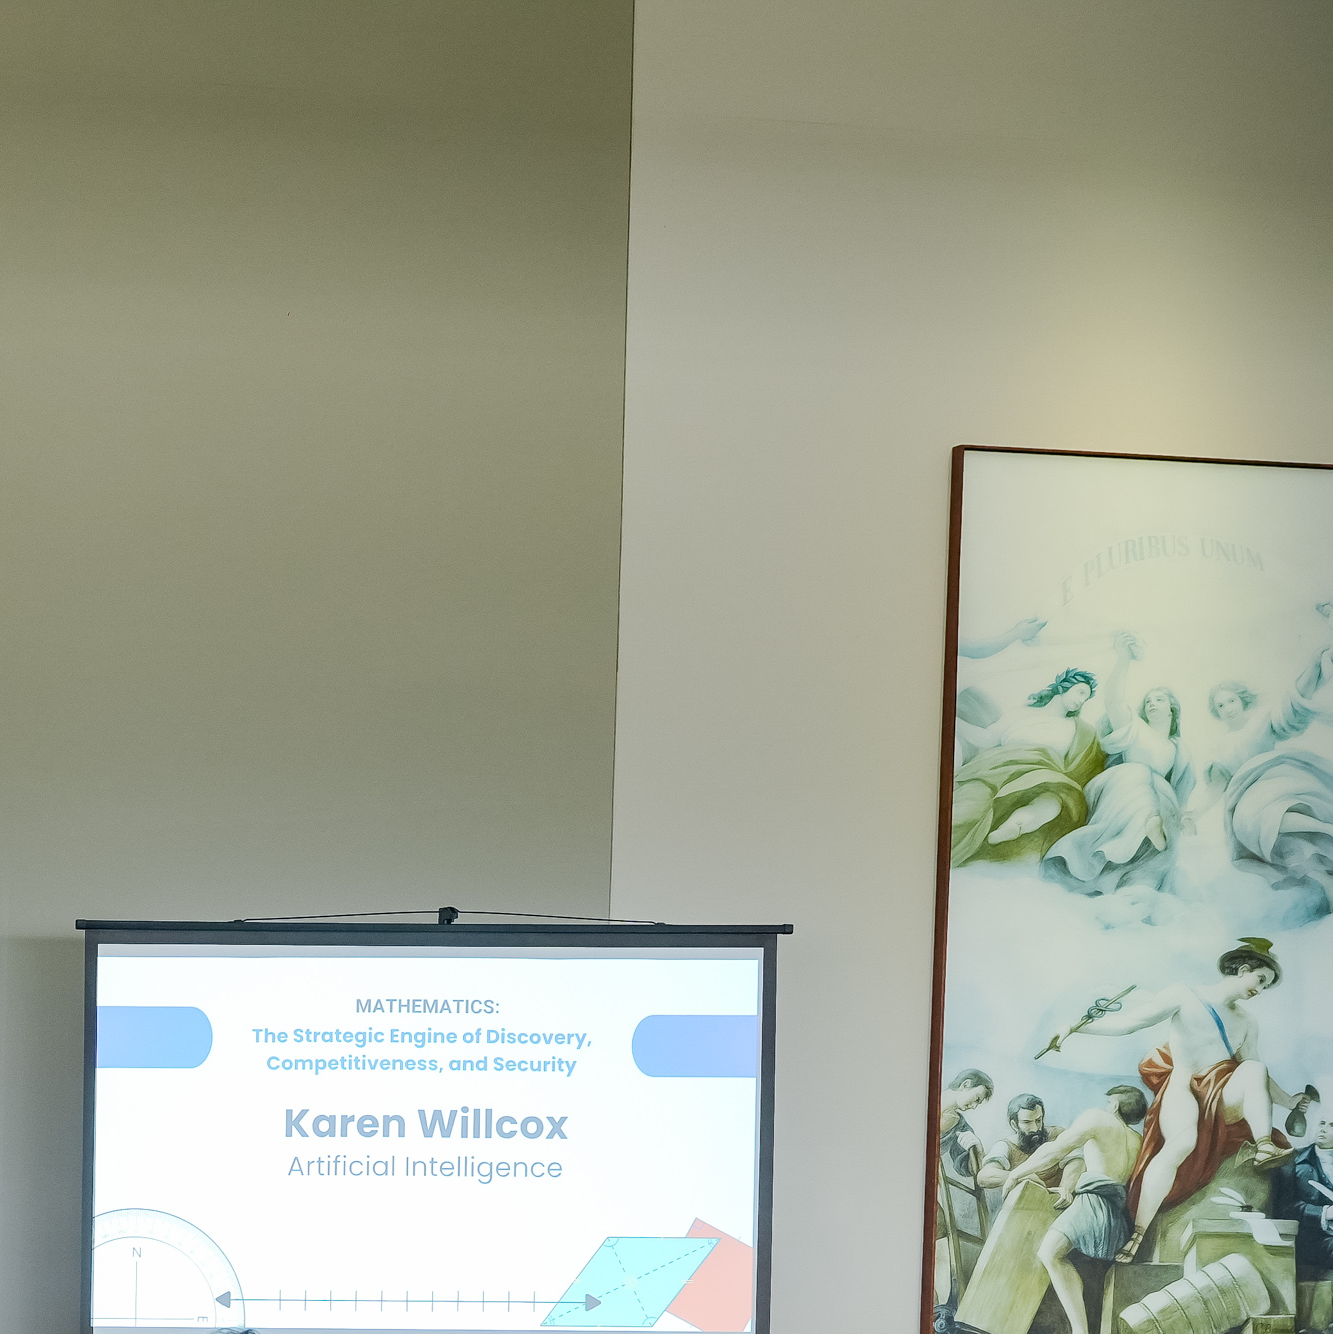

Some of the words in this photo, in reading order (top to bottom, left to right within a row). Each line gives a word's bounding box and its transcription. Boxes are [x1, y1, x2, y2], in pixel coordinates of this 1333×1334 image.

[1061, 574, 1074, 607] E
[1082, 534, 1191, 589] PLURIBUS
[1200, 536, 1266, 573] UNUM
[355, 998, 500, 1015] MATHEMATICS:
[252, 1028, 289, 1044] The
[293, 1027, 385, 1048] Strategic
[389, 1027, 458, 1049] Engine
[462, 1028, 483, 1045] of
[486, 1028, 593, 1050] Discovery,
[266, 1054, 444, 1076] Competitiveness,
[448, 1056, 489, 1072] and
[493, 1056, 578, 1078] Security
[284, 1108, 406, 1139] Karen
[416, 1105, 569, 1140] Willcox
[287, 1154, 396, 1177] Artificial
[405, 1155, 563, 1185] Intelligence
[132, 1246, 142, 1259] N
